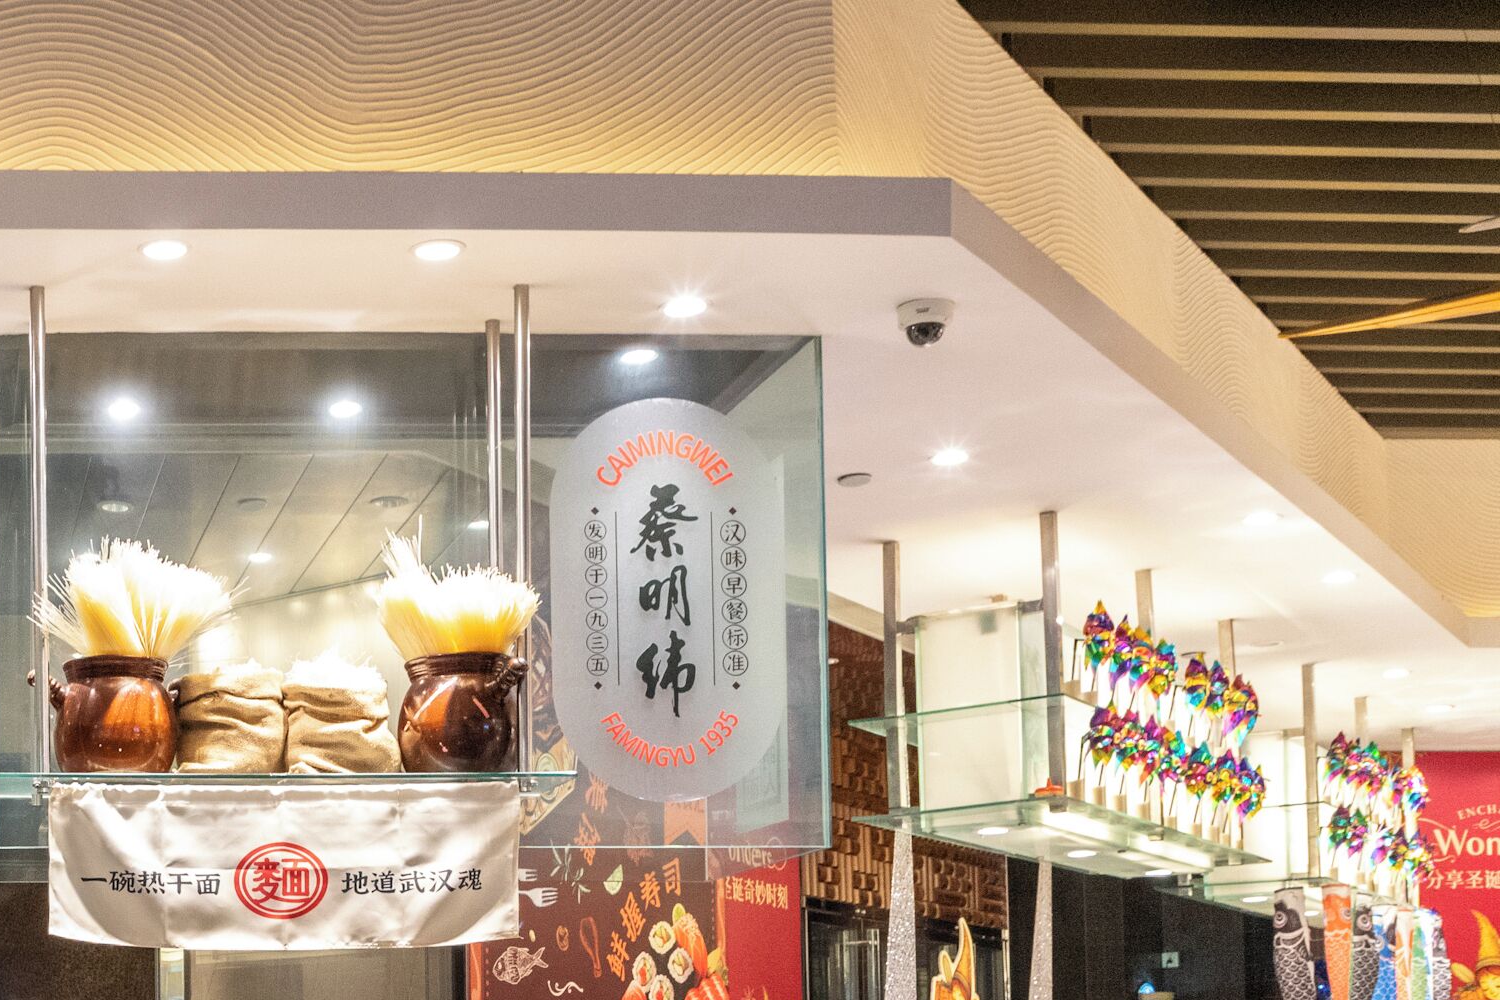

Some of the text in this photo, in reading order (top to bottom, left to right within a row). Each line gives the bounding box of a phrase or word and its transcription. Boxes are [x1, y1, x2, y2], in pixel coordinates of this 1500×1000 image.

[596, 430, 734, 487] CAIMINGWEI
[586, 521, 609, 675] 发明于一九三五
[723, 522, 747, 675] 汉味早餐标准
[600, 709, 740, 768] FAMINGYU 1935
[1457, 804, 1500, 820] ENCH
[80, 869, 221, 896] 一碗热干面
[341, 868, 483, 896] 地道武汉魂
